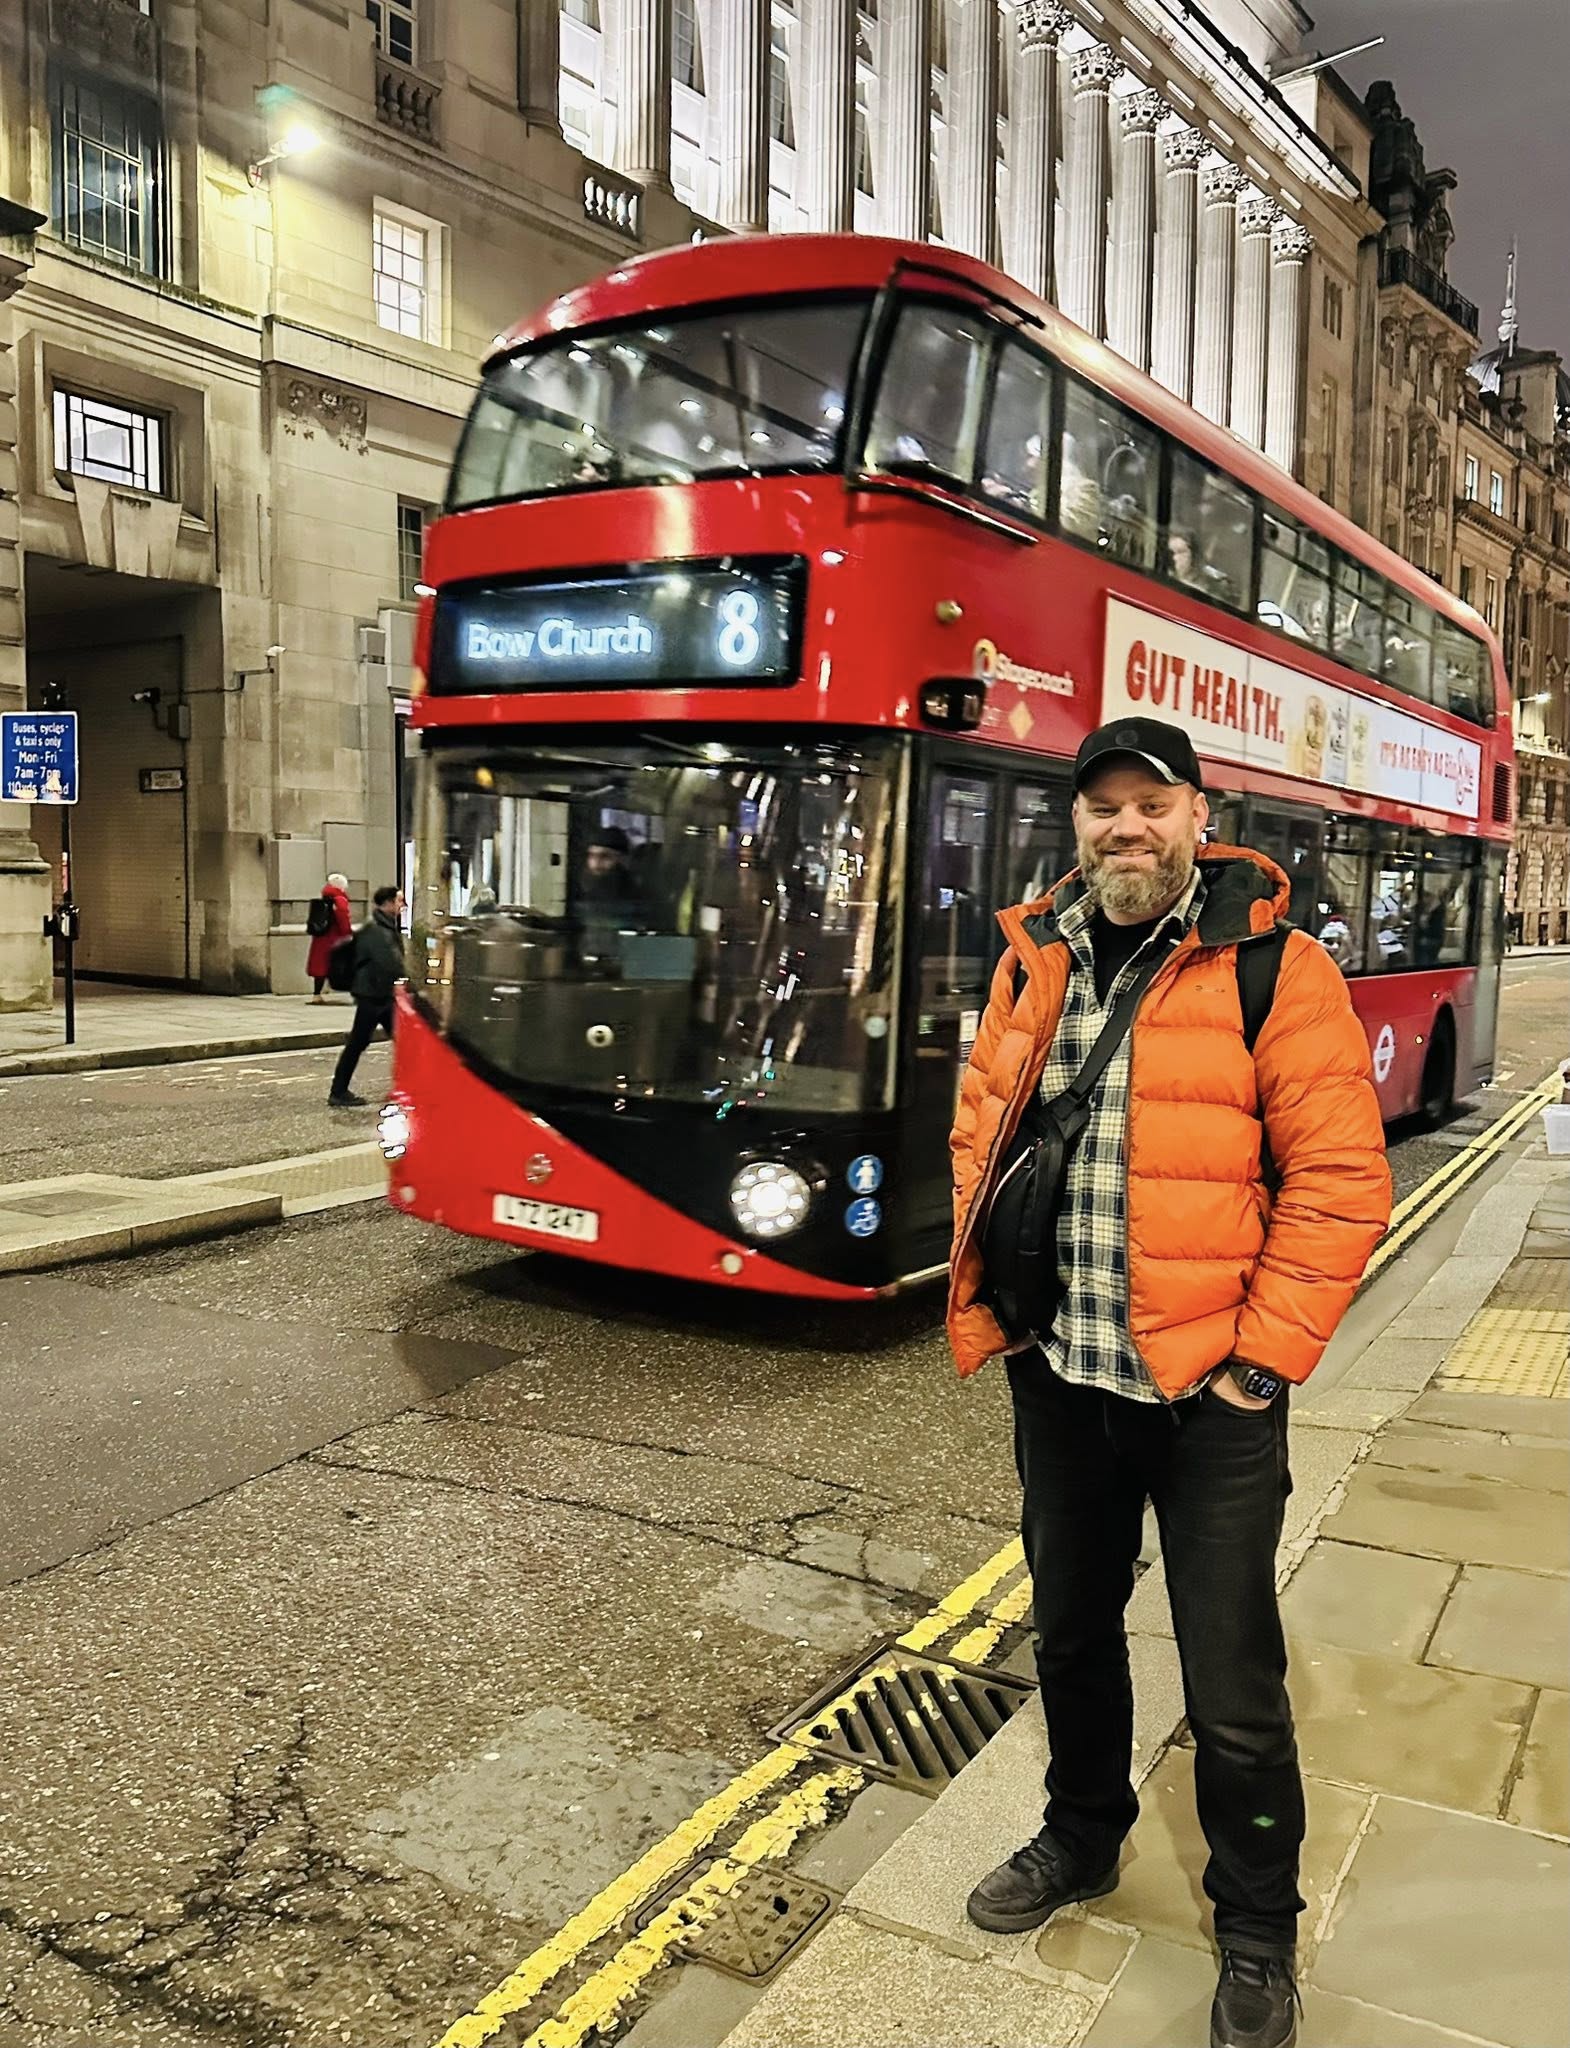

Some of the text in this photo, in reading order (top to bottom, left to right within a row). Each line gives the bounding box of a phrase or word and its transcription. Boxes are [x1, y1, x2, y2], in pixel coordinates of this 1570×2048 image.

[468, 614, 652, 659] Bow Church
[719, 589, 760, 665] 8
[996, 653, 1074, 697] Stagecoach
[1126, 640, 1186, 711] GUT
[1191, 664, 1284, 743] HEALTH.
[13, 722, 64, 735] Buses, cycles
[15, 736, 61, 748] & taxis only
